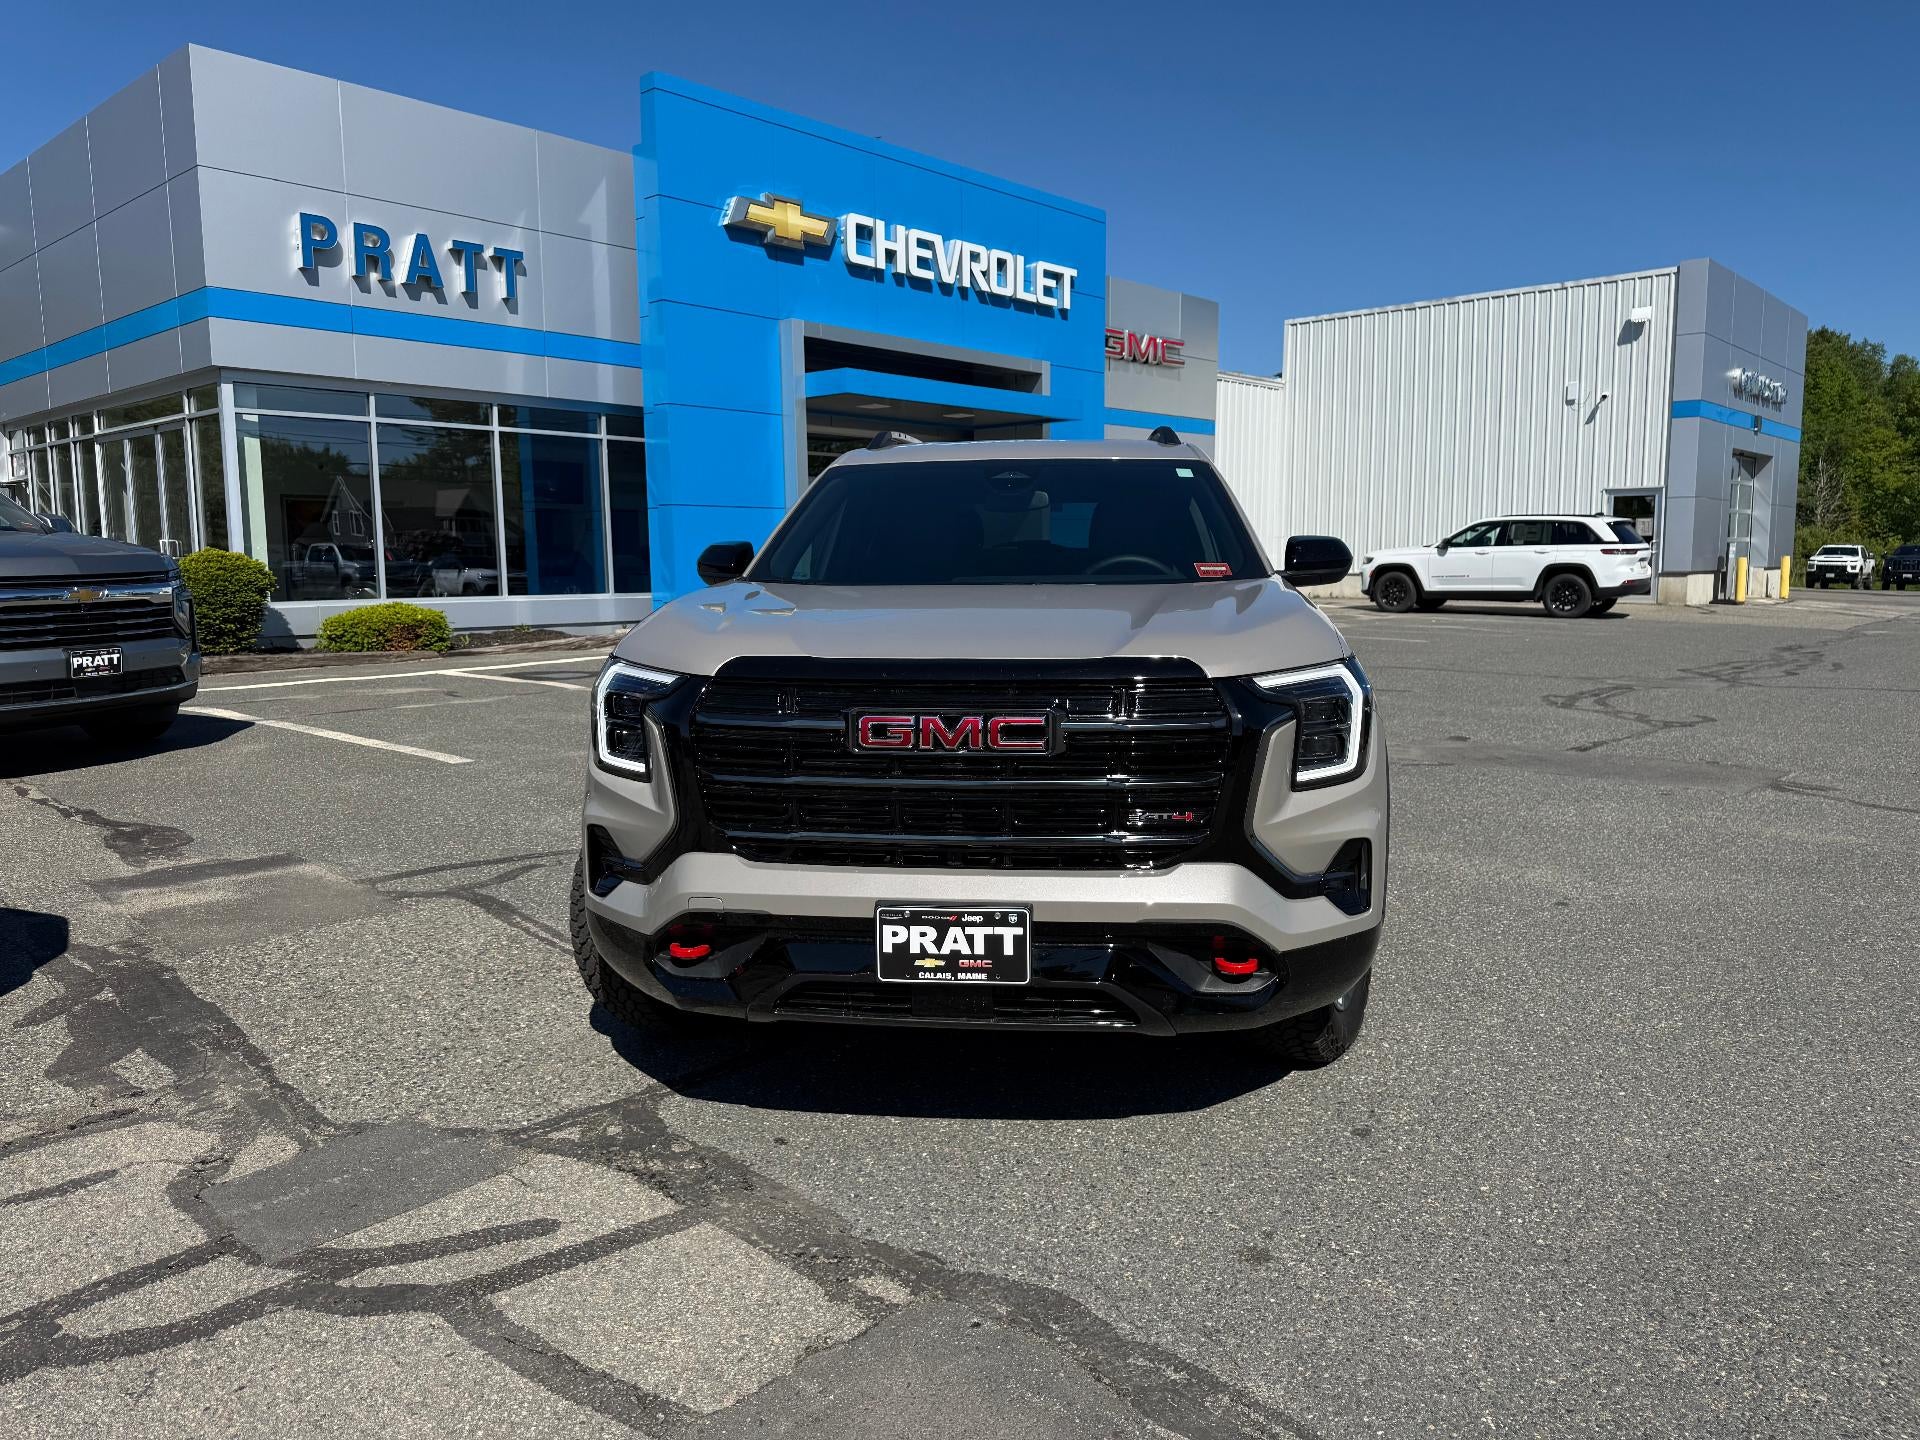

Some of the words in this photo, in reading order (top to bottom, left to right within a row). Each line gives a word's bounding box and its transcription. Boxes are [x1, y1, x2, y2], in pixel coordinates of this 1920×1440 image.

[296, 211, 524, 299] PRATT
[843, 212, 1078, 310] CHEVROLET
[1105, 327, 1185, 368] GMC
[72, 653, 120, 669] PRATT
[859, 716, 1046, 749] GMC
[1139, 811, 1193, 822] AT4
[961, 914, 984, 923] Jeep
[882, 925, 1024, 956] PRATT
[958, 959, 993, 968] GMC
[918, 972, 955, 981] CALAIS,
[957, 972, 988, 980] MAINE
